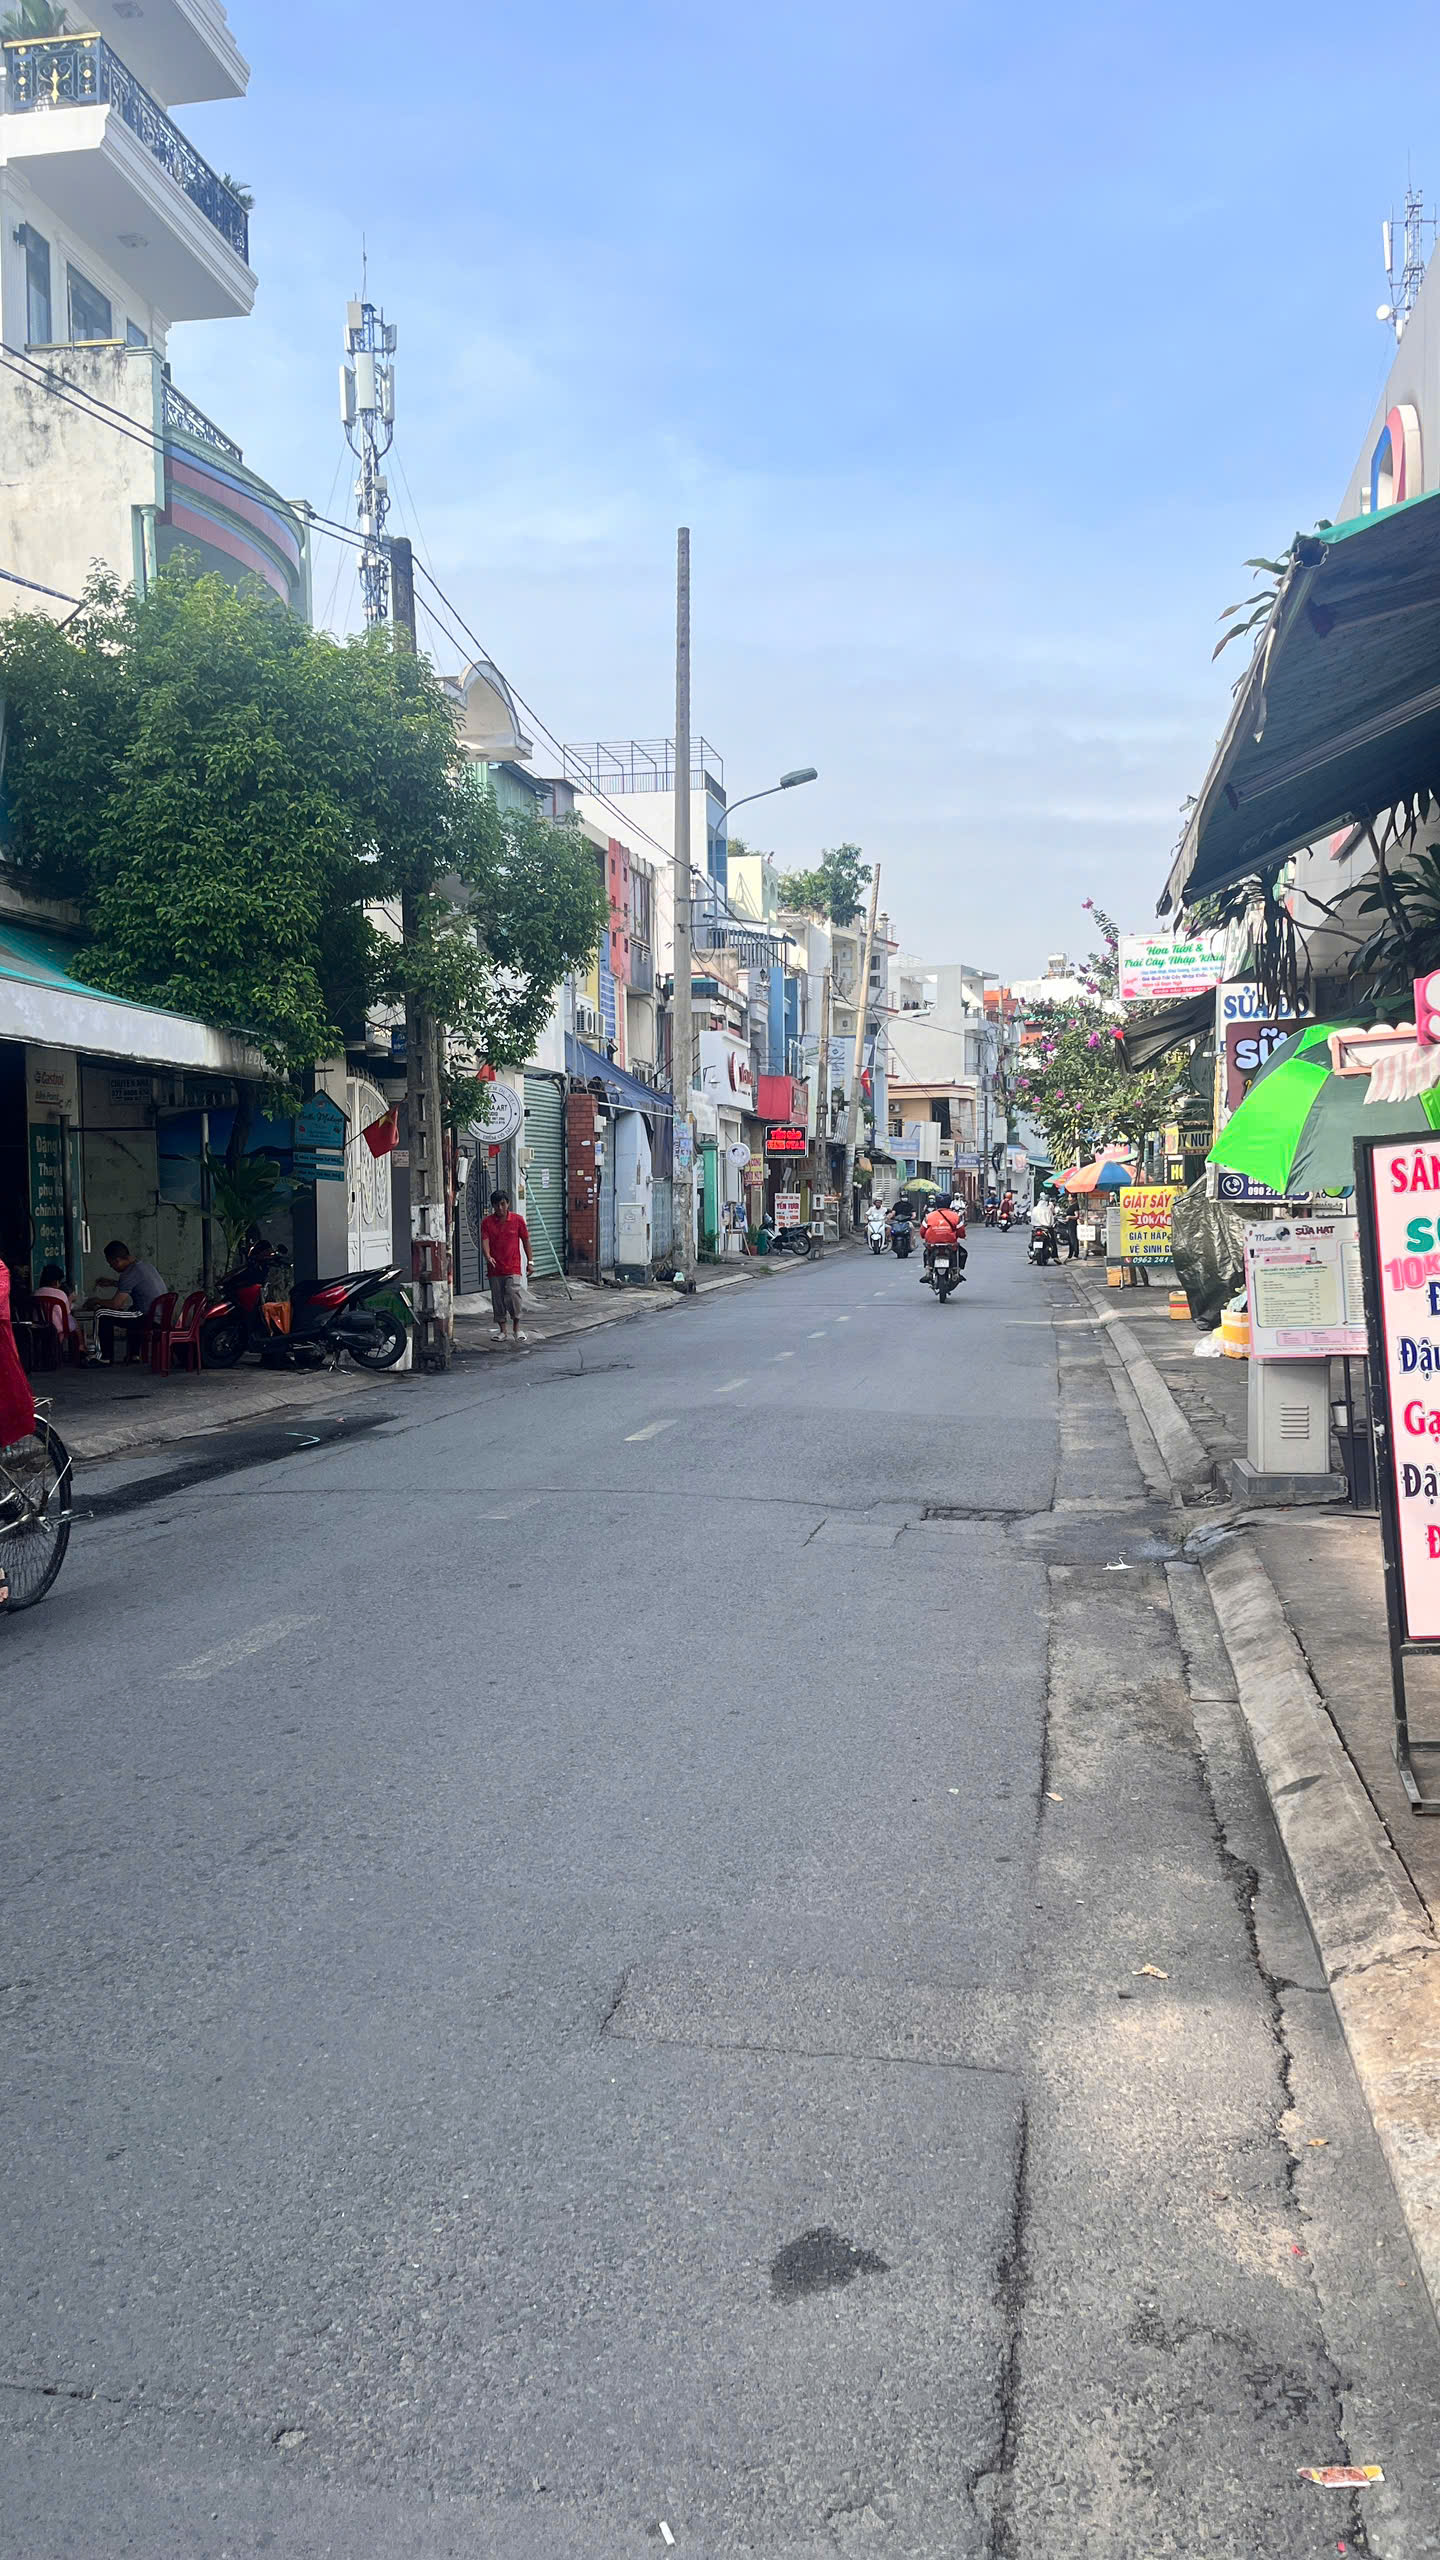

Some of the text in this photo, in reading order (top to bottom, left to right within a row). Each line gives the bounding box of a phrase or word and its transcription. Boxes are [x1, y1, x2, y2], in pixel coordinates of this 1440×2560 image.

[1248, 1186, 1265, 1196] 090
[1123, 1189, 1172, 1212] GIẶT SẤY
[1143, 1245, 1162, 1254] SINH
